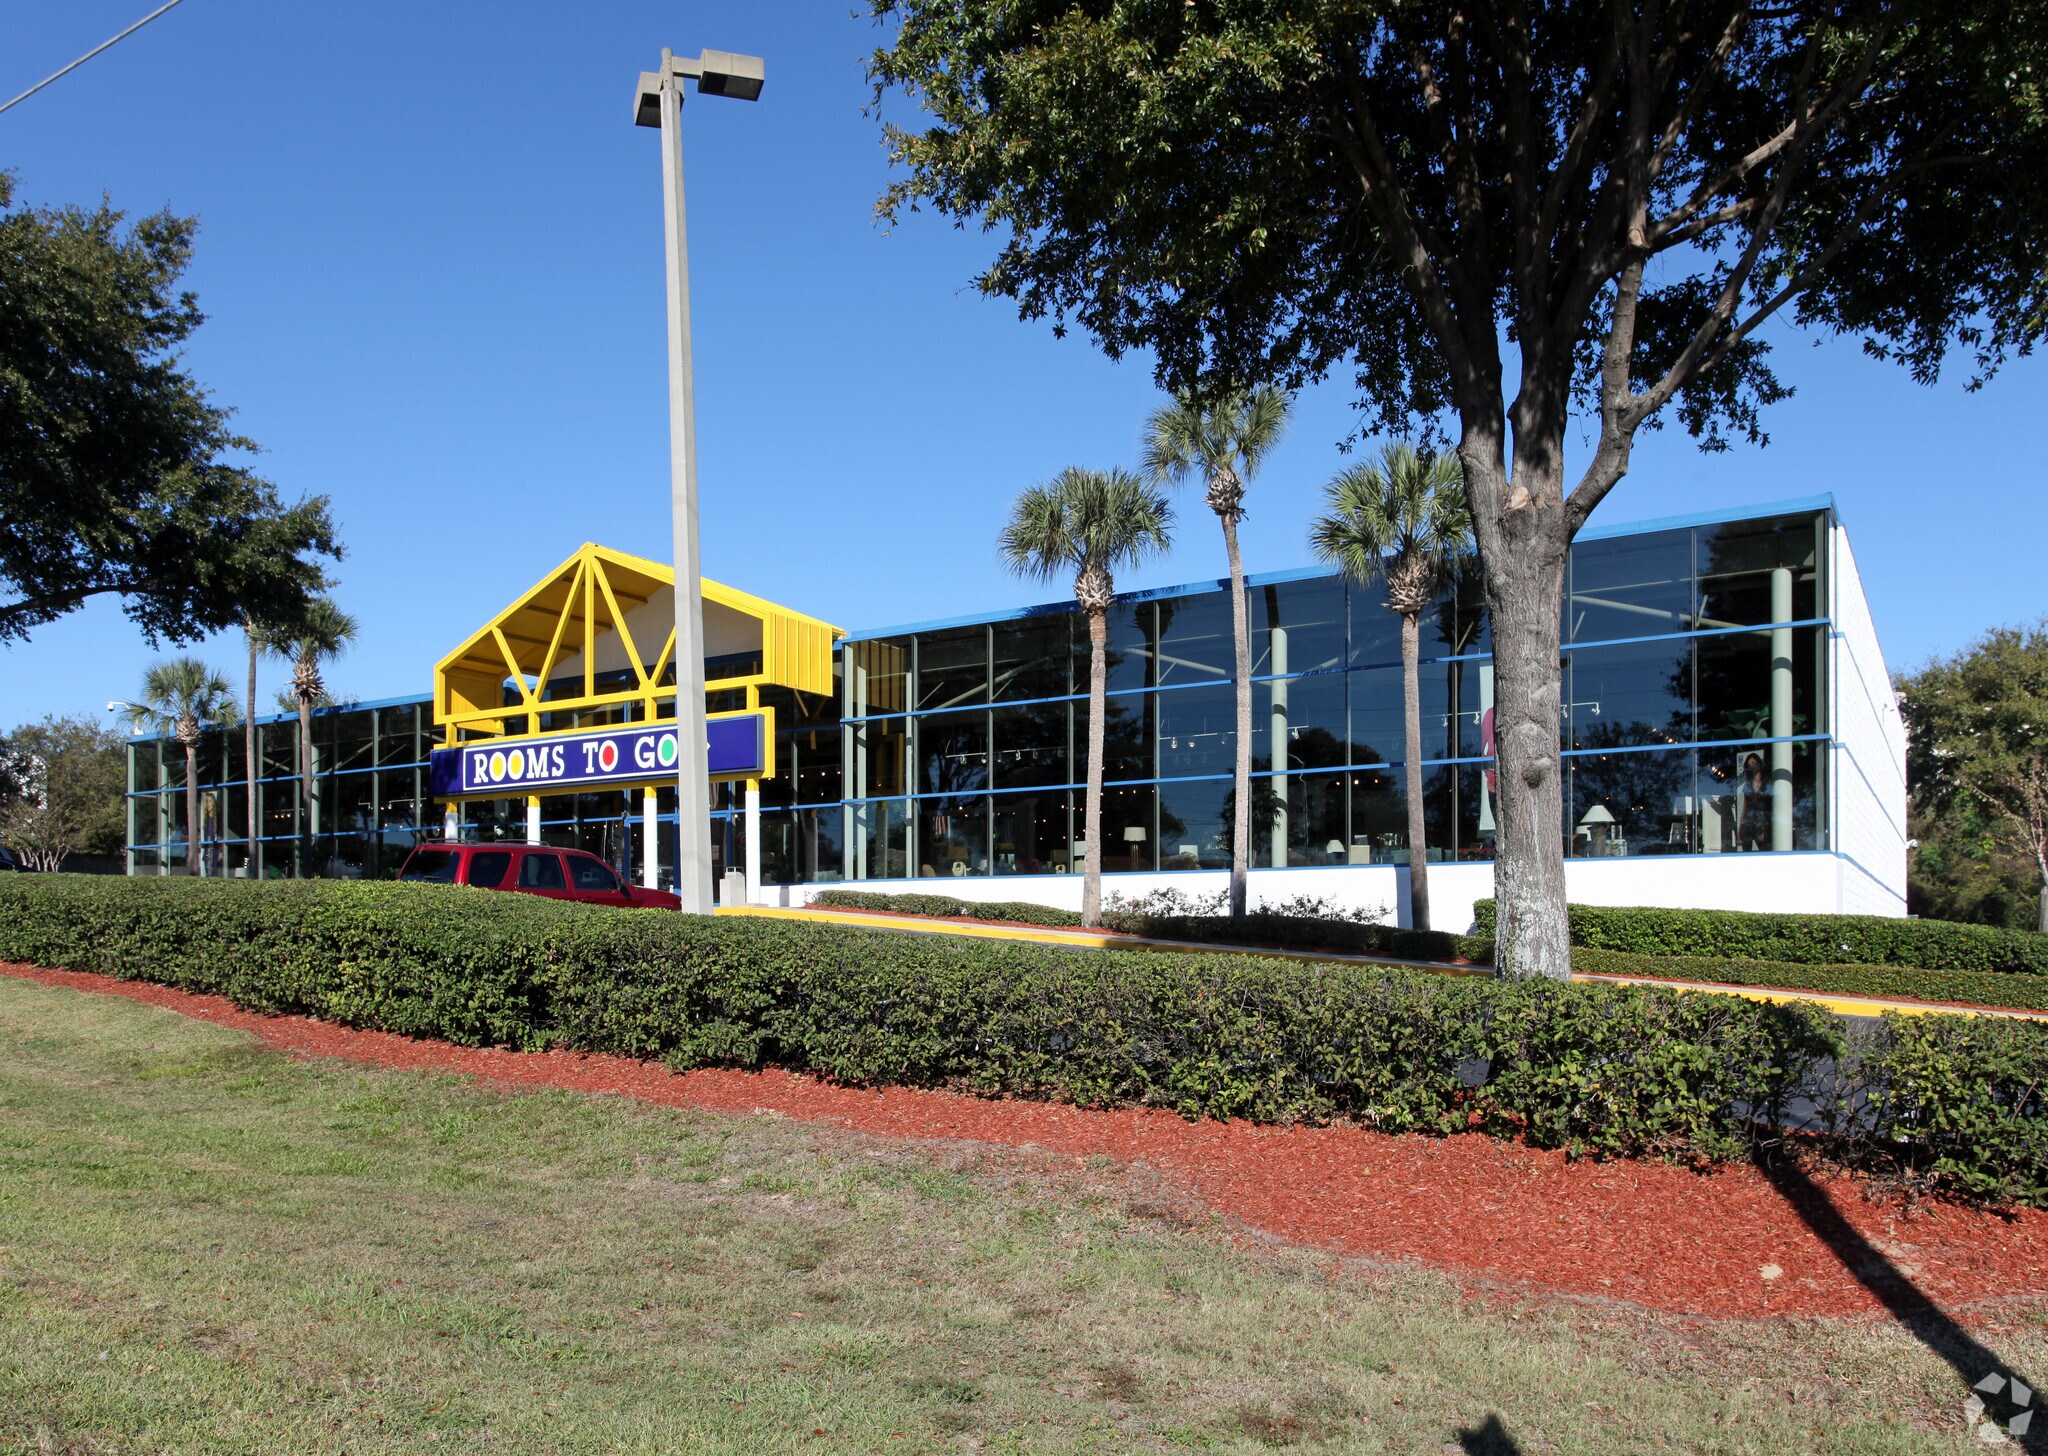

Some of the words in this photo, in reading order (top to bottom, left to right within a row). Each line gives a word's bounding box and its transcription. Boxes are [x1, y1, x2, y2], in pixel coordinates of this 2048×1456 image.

[473, 745, 565, 784] ROOMS
[583, 740, 619, 773] TO
[634, 733, 679, 769] GO
